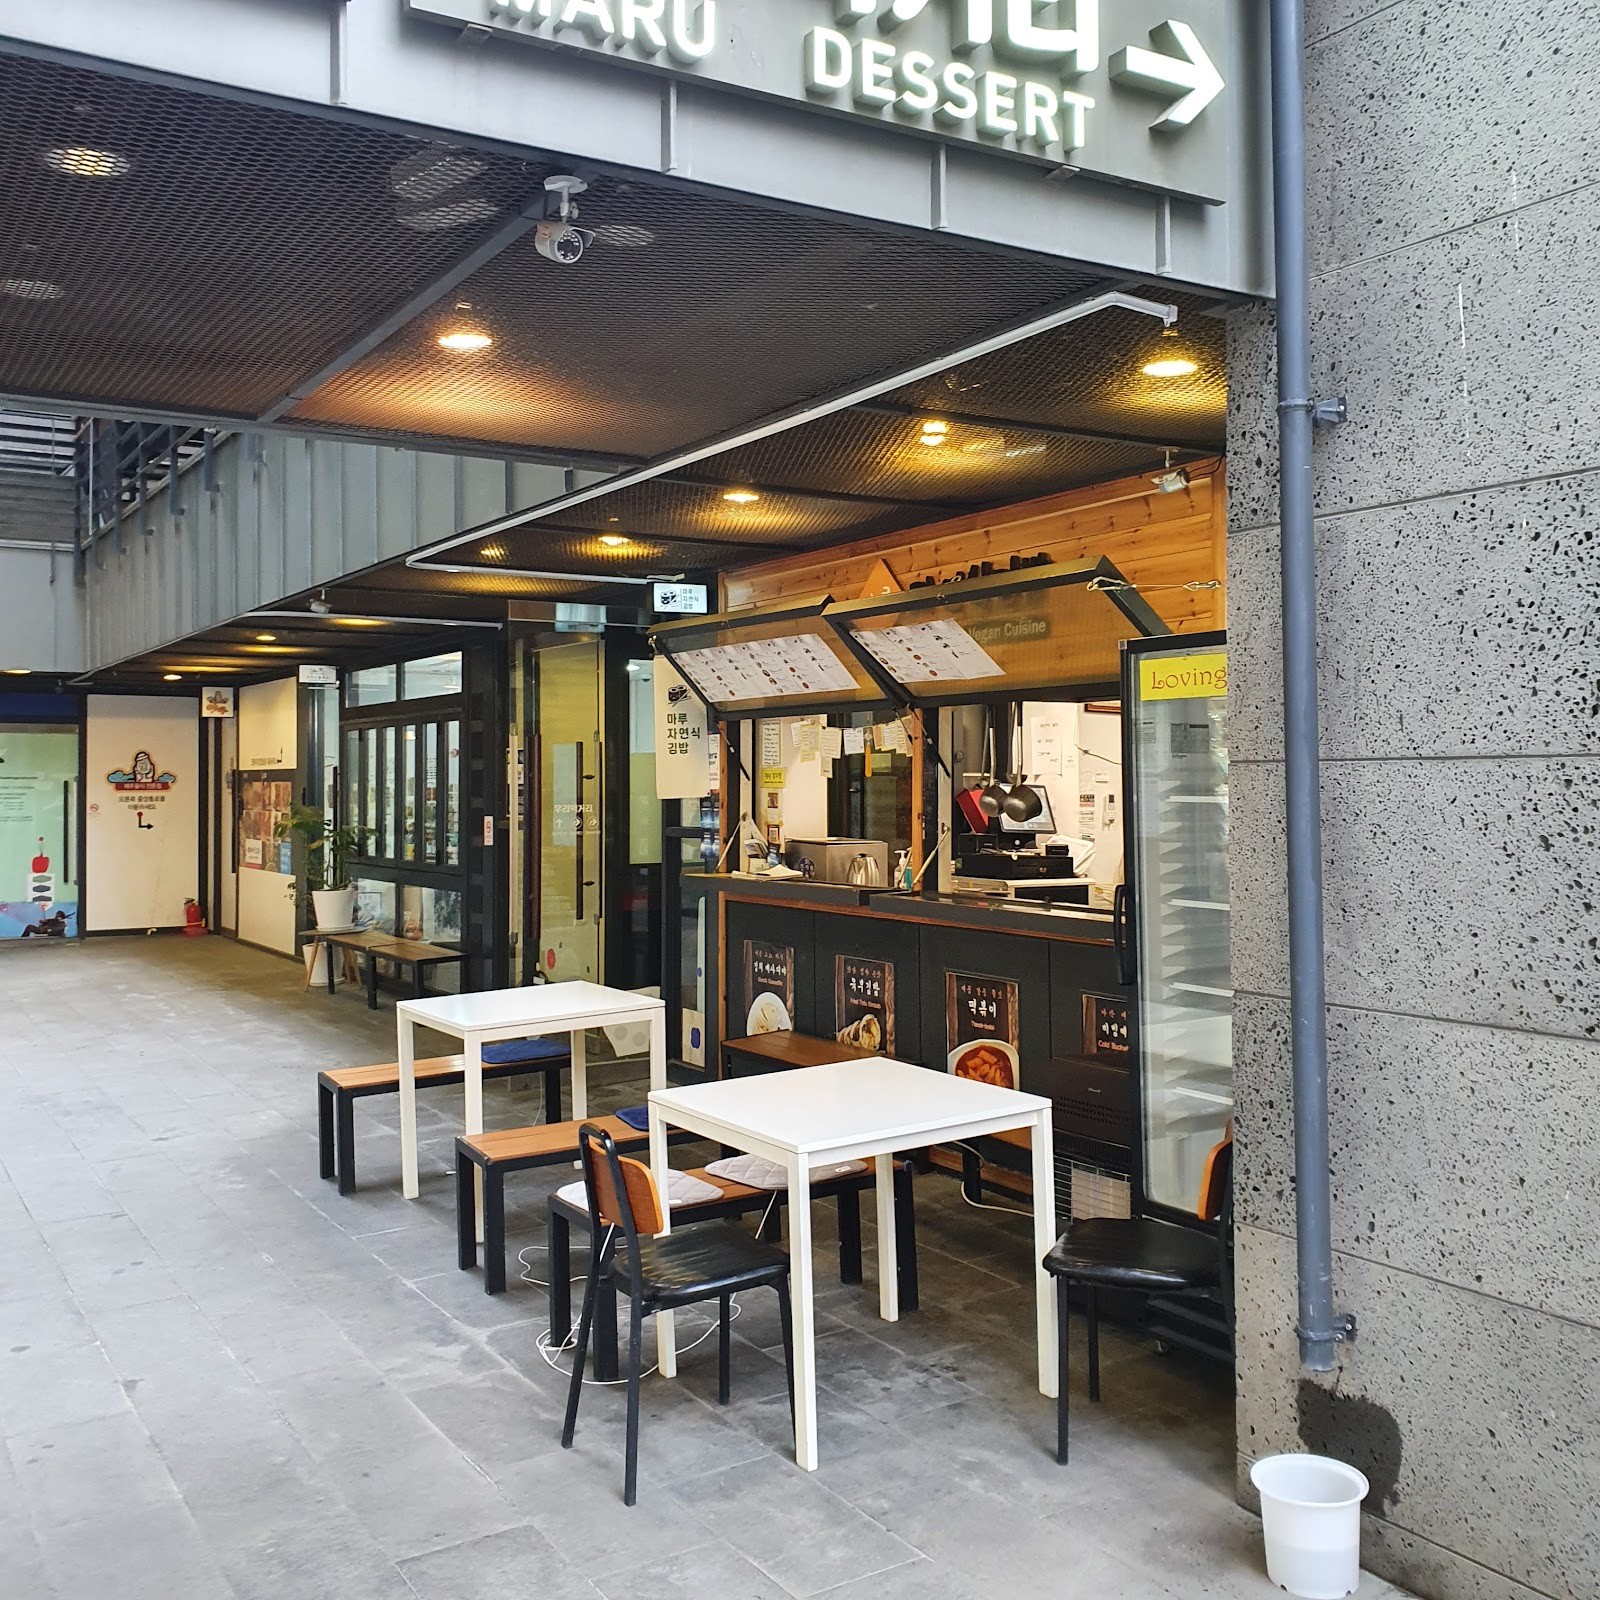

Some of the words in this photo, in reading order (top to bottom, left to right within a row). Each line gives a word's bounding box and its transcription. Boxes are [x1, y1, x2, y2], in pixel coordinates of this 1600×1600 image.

[812, 25, 1096, 149] DESSERT
[1003, 618, 1048, 637] Cuisine
[1152, 666, 1227, 690] Loving
[667, 712, 688, 725] 마루
[667, 727, 701, 740] 자연식
[668, 742, 689, 755] 김밥
[554, 804, 593, 813] 우리먹거리
[849, 977, 881, 997] 유부김밥
[967, 997, 997, 1019] 떡볶이
[1098, 1040, 1111, 1050] Cold
